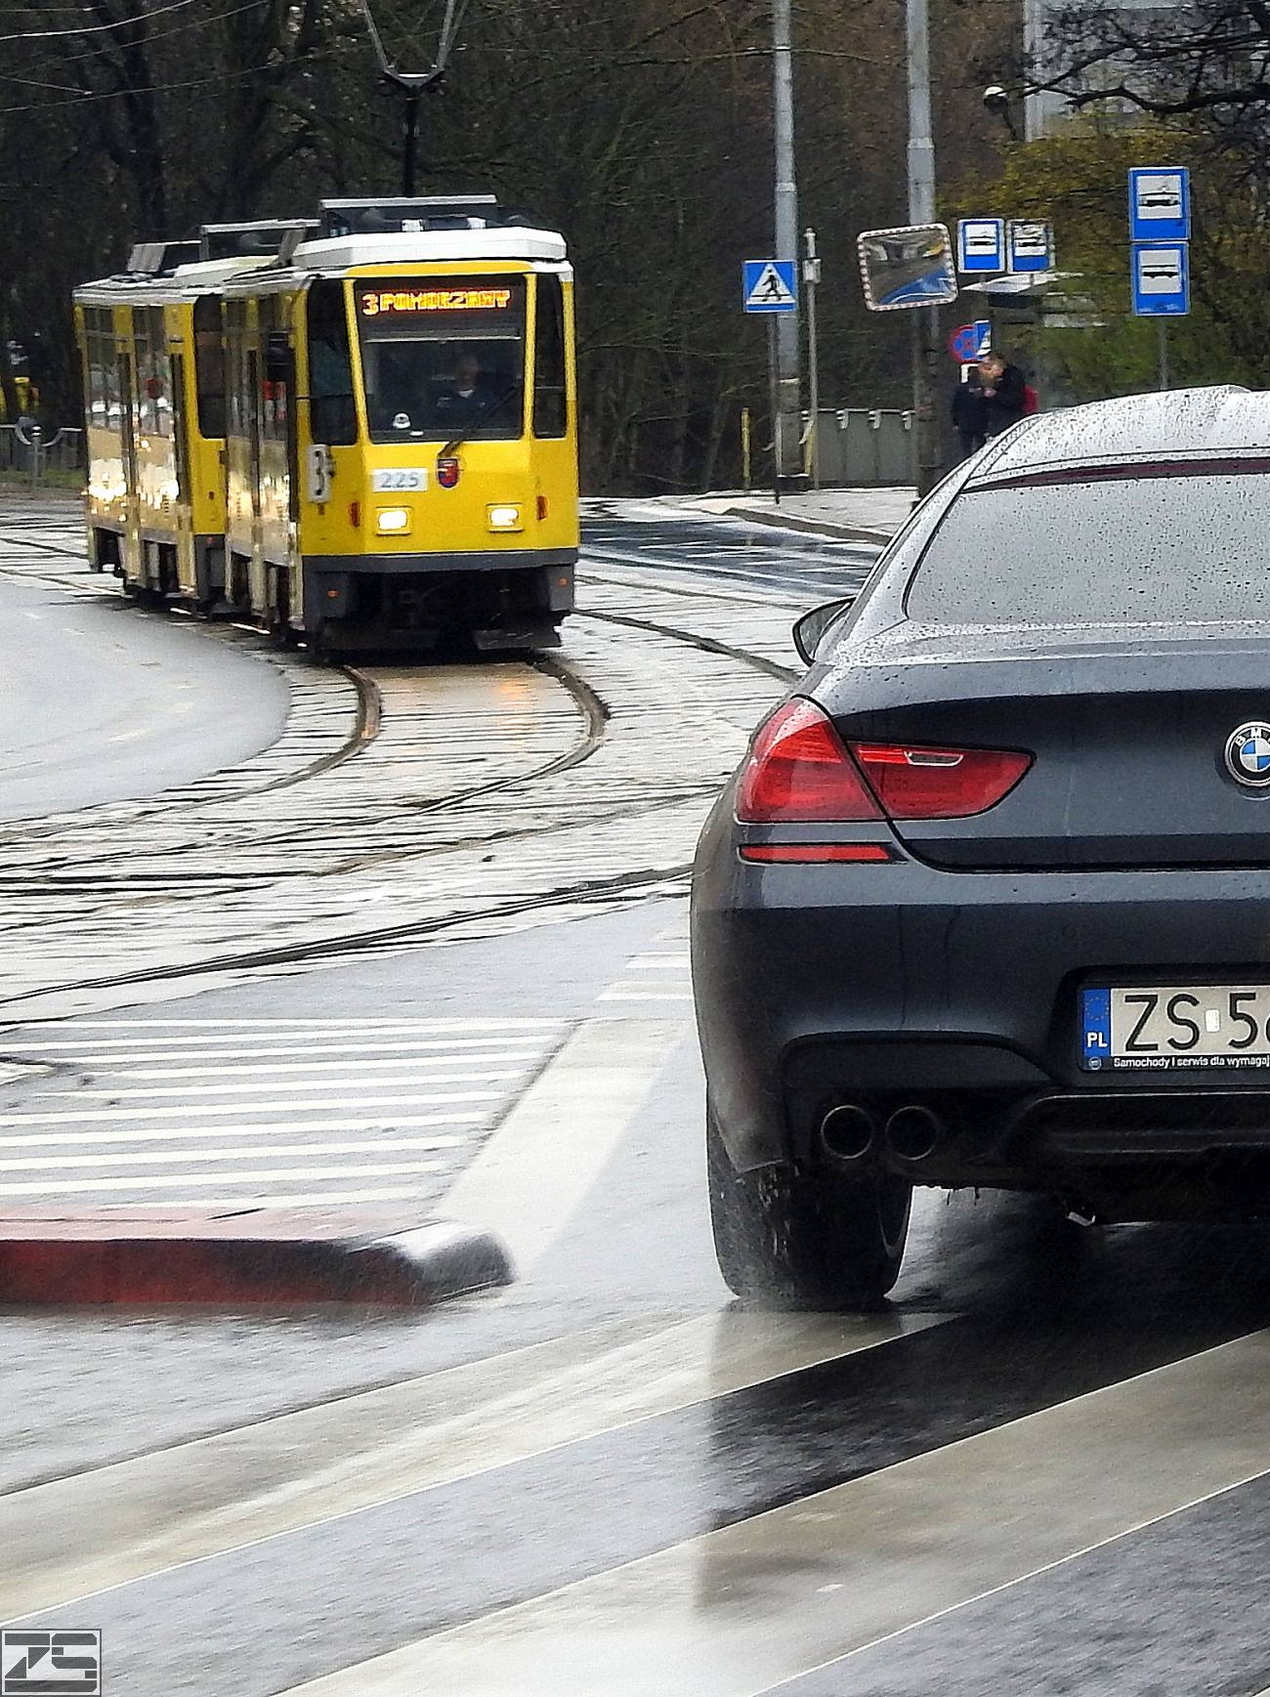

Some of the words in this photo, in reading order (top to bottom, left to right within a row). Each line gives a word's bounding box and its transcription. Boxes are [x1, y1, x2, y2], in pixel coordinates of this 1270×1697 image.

[362, 293, 379, 316] 3
[380, 471, 419, 489] 225
[1124, 993, 1201, 1052] ZS
[1087, 1032, 1108, 1048] PL
[1114, 1057, 1170, 1069] Samochody
[1177, 1057, 1208, 1067] serwis
[1210, 1056, 1225, 1066] dla
